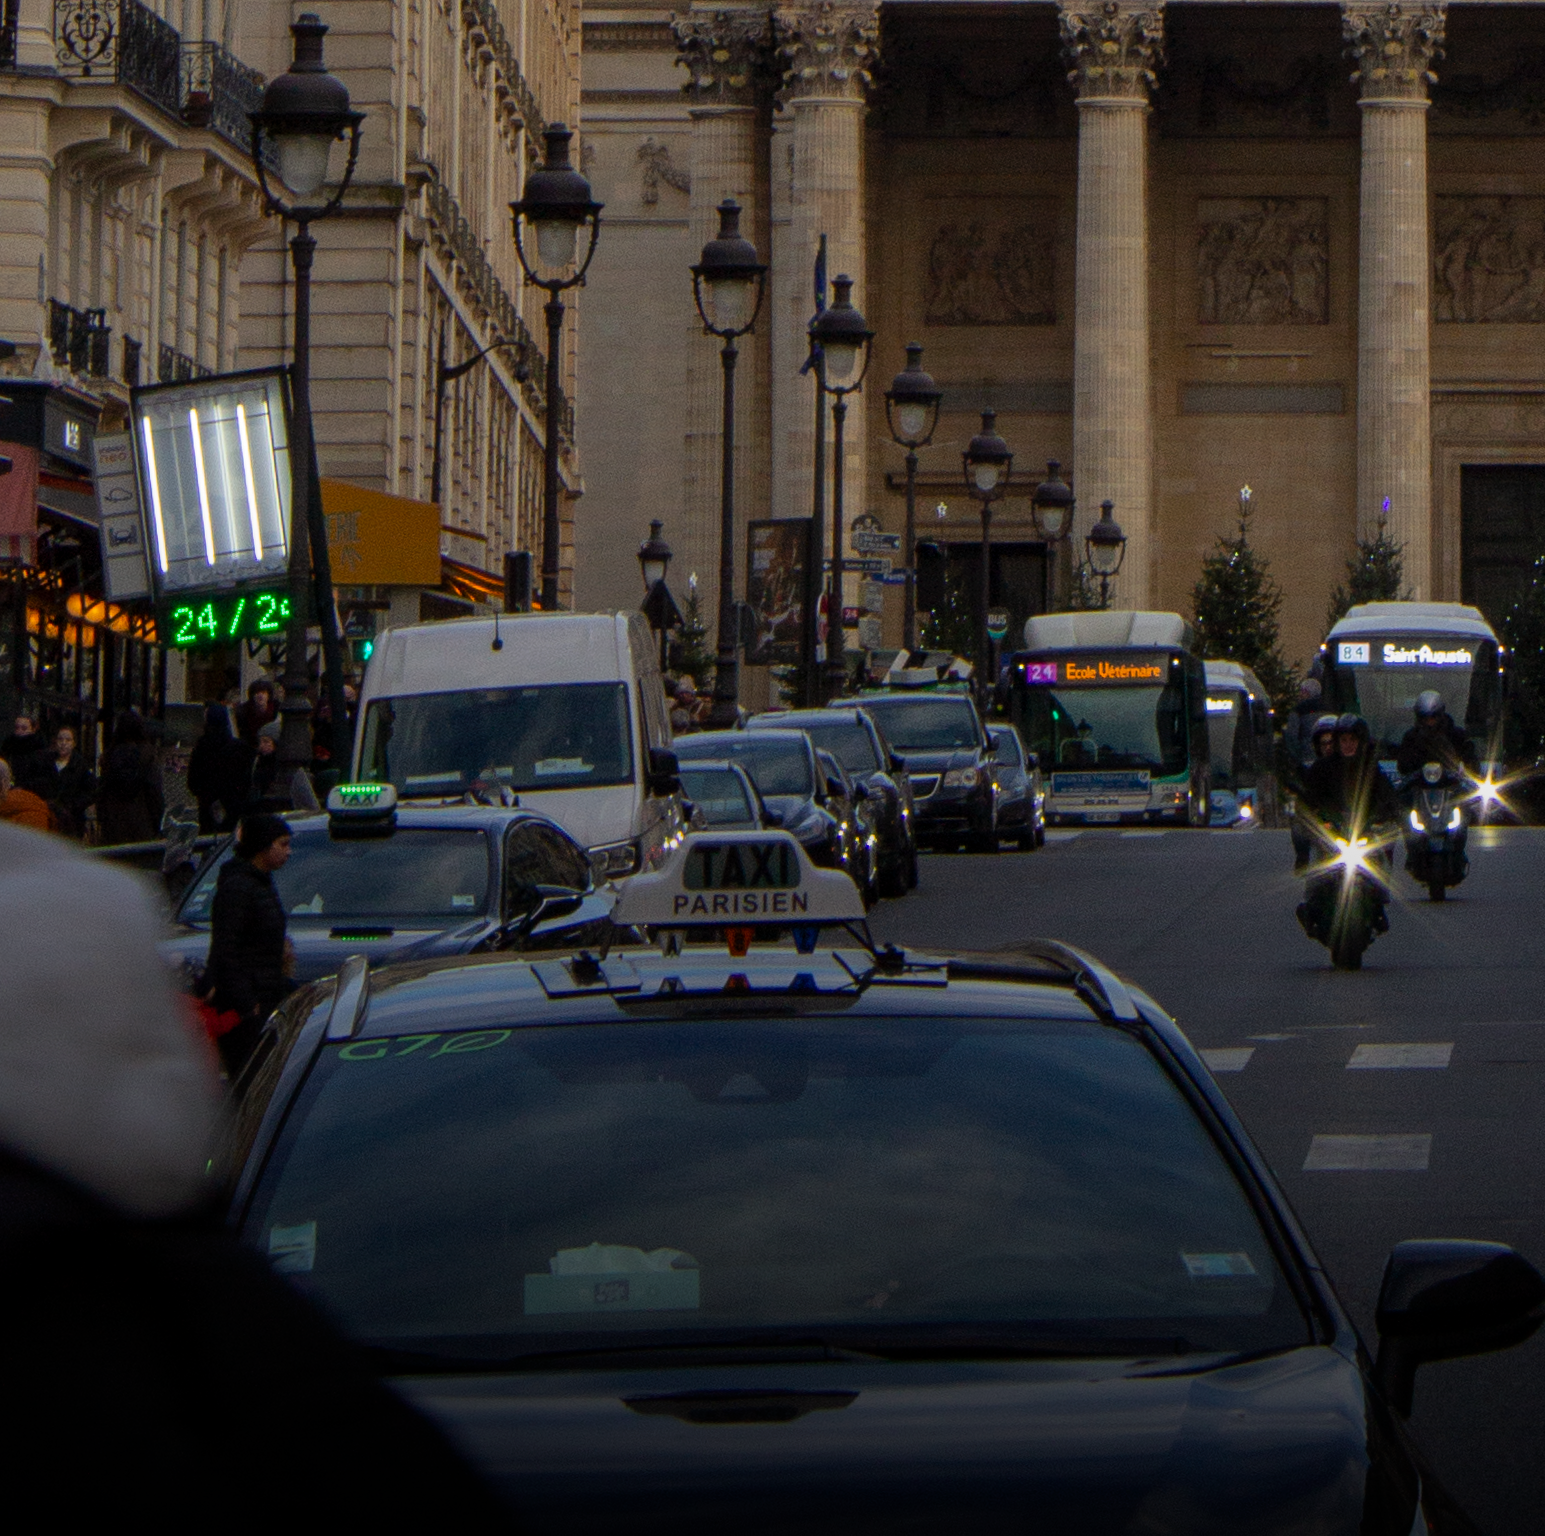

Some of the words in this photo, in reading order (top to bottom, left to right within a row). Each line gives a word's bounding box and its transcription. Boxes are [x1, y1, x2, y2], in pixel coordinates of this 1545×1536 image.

[1342, 645, 1364, 661] 84
[1031, 665, 1053, 681] 24
[1065, 661, 1097, 680] Ecole
[341, 792, 379, 805] TAXI
[695, 844, 789, 888] TAXI
[673, 892, 809, 915] PARISIEN
[337, 1032, 442, 1061] G7
